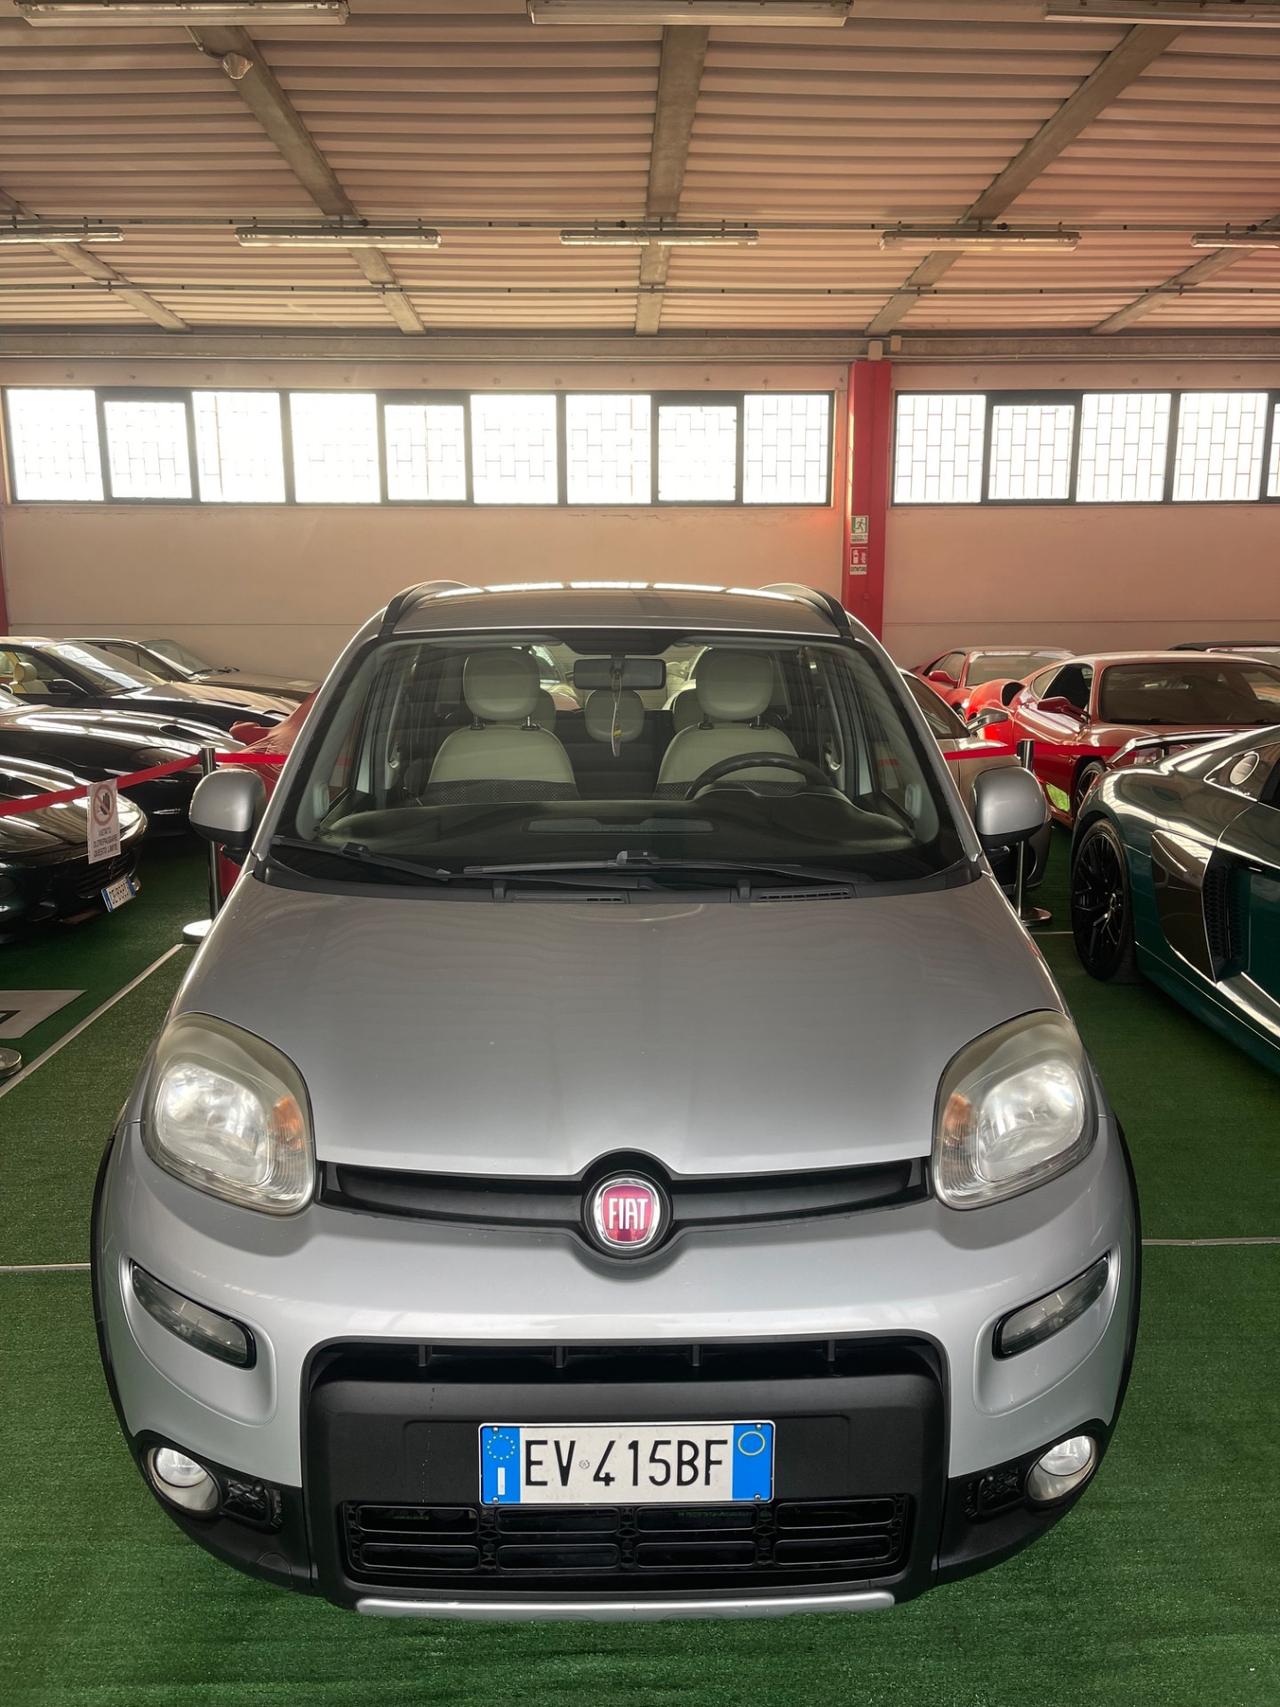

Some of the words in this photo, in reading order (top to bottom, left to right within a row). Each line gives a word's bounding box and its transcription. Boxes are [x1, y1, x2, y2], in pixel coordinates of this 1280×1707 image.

[608, 1197, 649, 1230] FIAT
[524, 1439, 577, 1487] EV
[592, 1439, 729, 1487] 415BF
